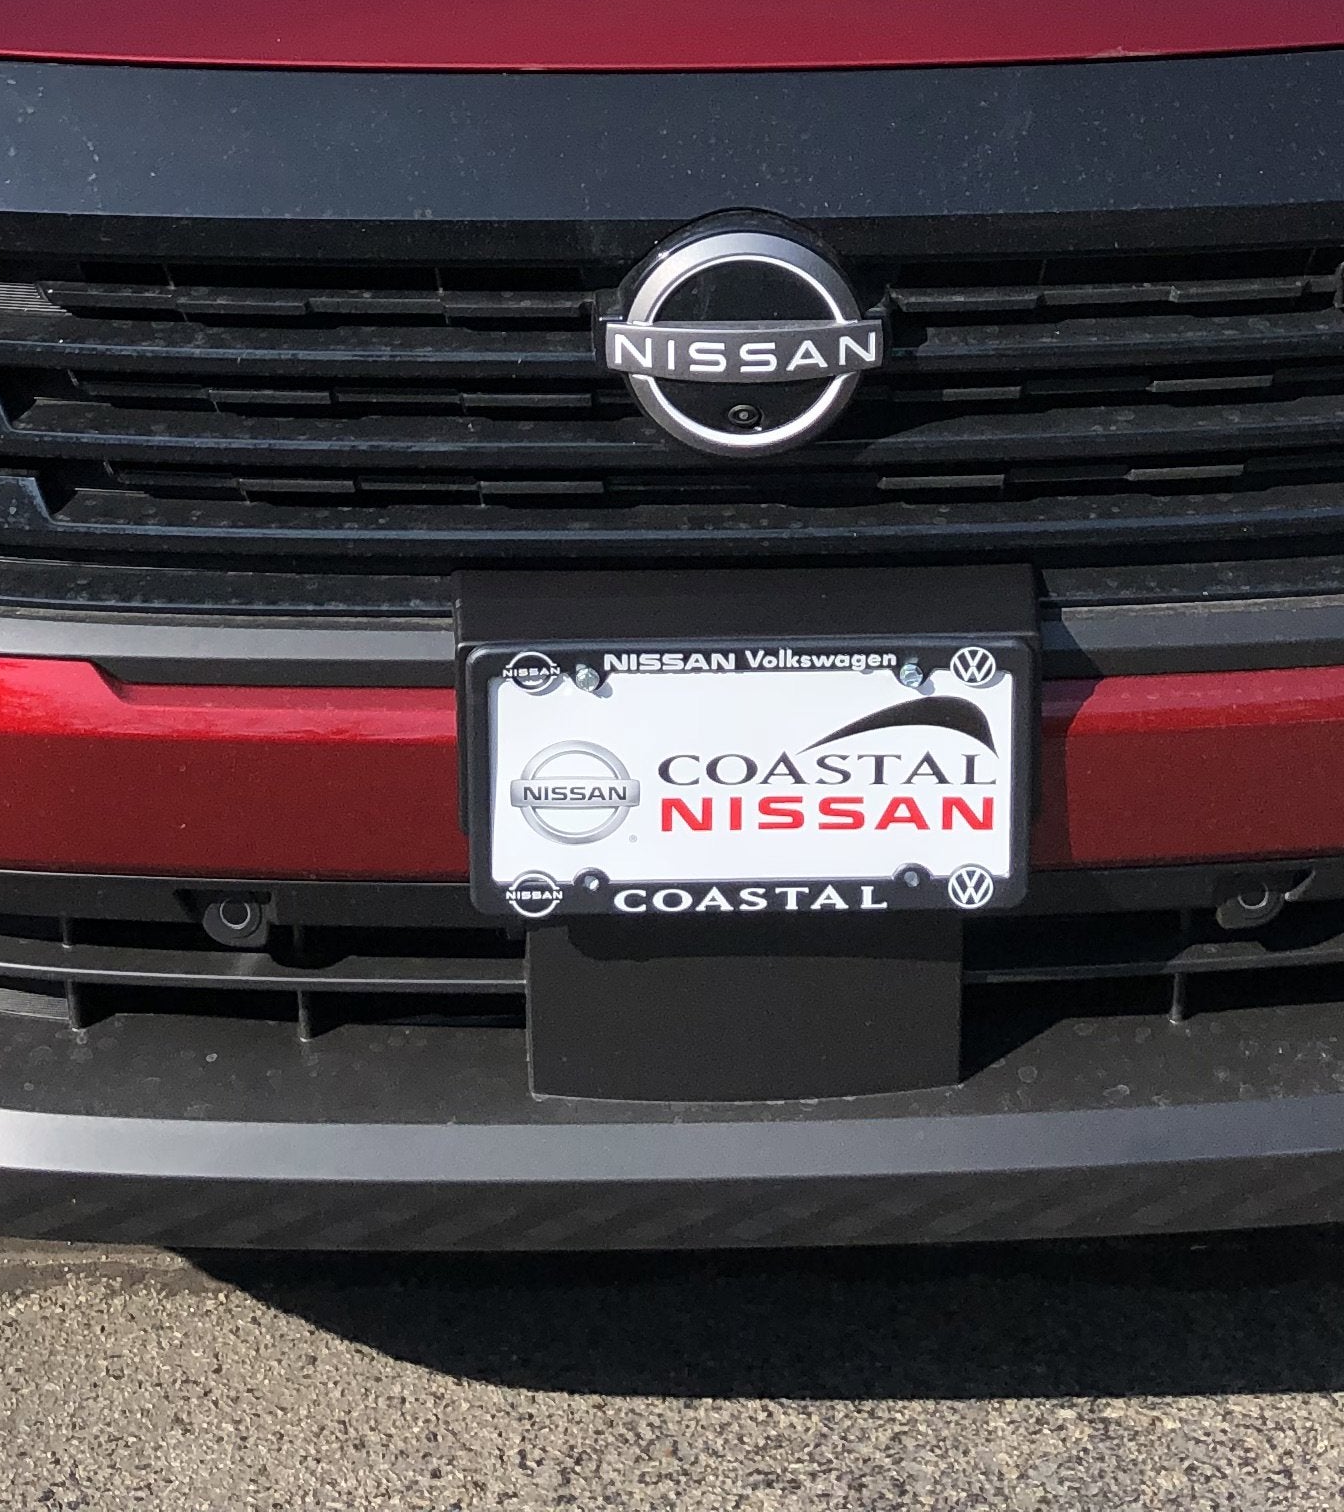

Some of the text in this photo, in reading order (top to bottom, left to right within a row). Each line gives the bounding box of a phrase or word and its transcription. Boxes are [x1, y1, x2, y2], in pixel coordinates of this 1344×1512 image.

[614, 331, 877, 373] NISSAN
[502, 665, 561, 677] NISSAN
[603, 649, 897, 671] NISSAN Volkswagen
[657, 751, 997, 785] COASTAL
[523, 786, 627, 801] NISSAN
[661, 796, 994, 831] NISSAN
[505, 888, 563, 901] NISSAN
[613, 884, 888, 912] COASTAL
